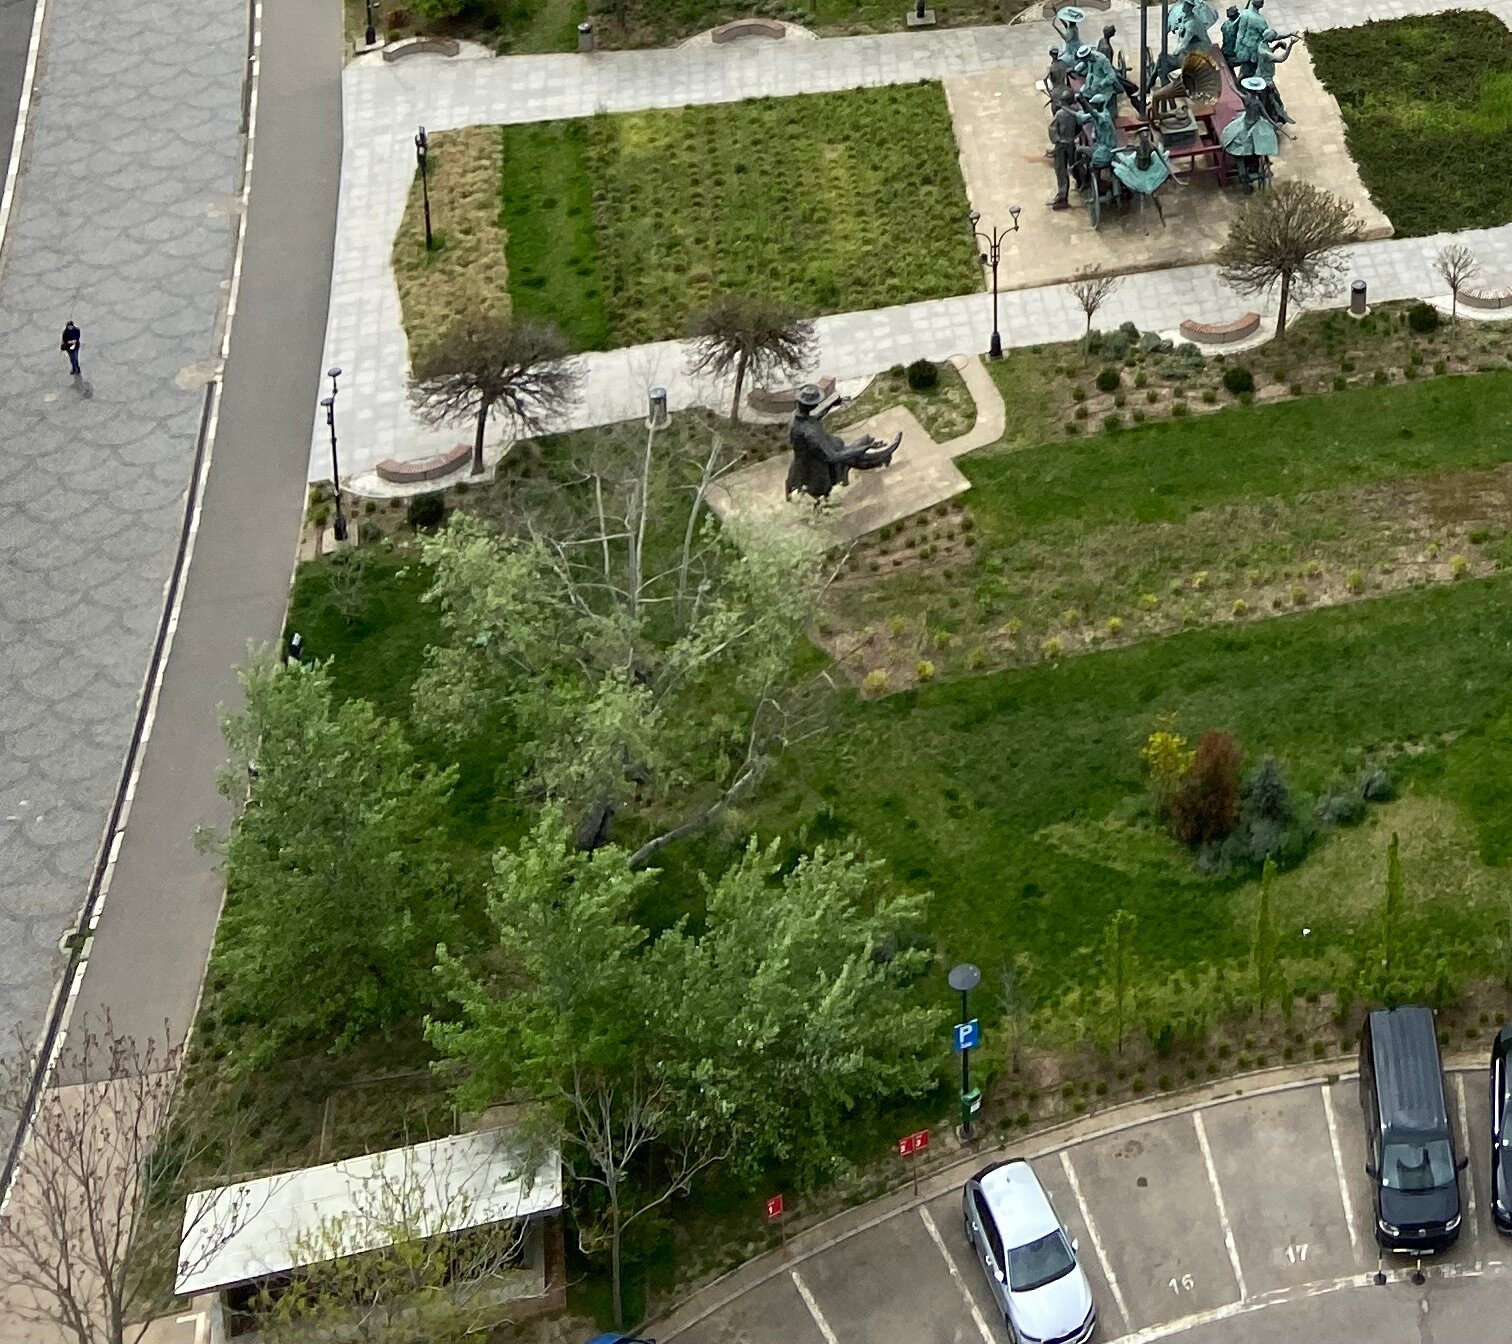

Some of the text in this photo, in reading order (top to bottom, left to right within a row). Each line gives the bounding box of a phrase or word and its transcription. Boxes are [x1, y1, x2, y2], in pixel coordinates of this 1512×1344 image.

[960, 1024, 972, 1043] P
[1285, 1243, 1309, 1264] 17
[1168, 1274, 1194, 1295] 16
